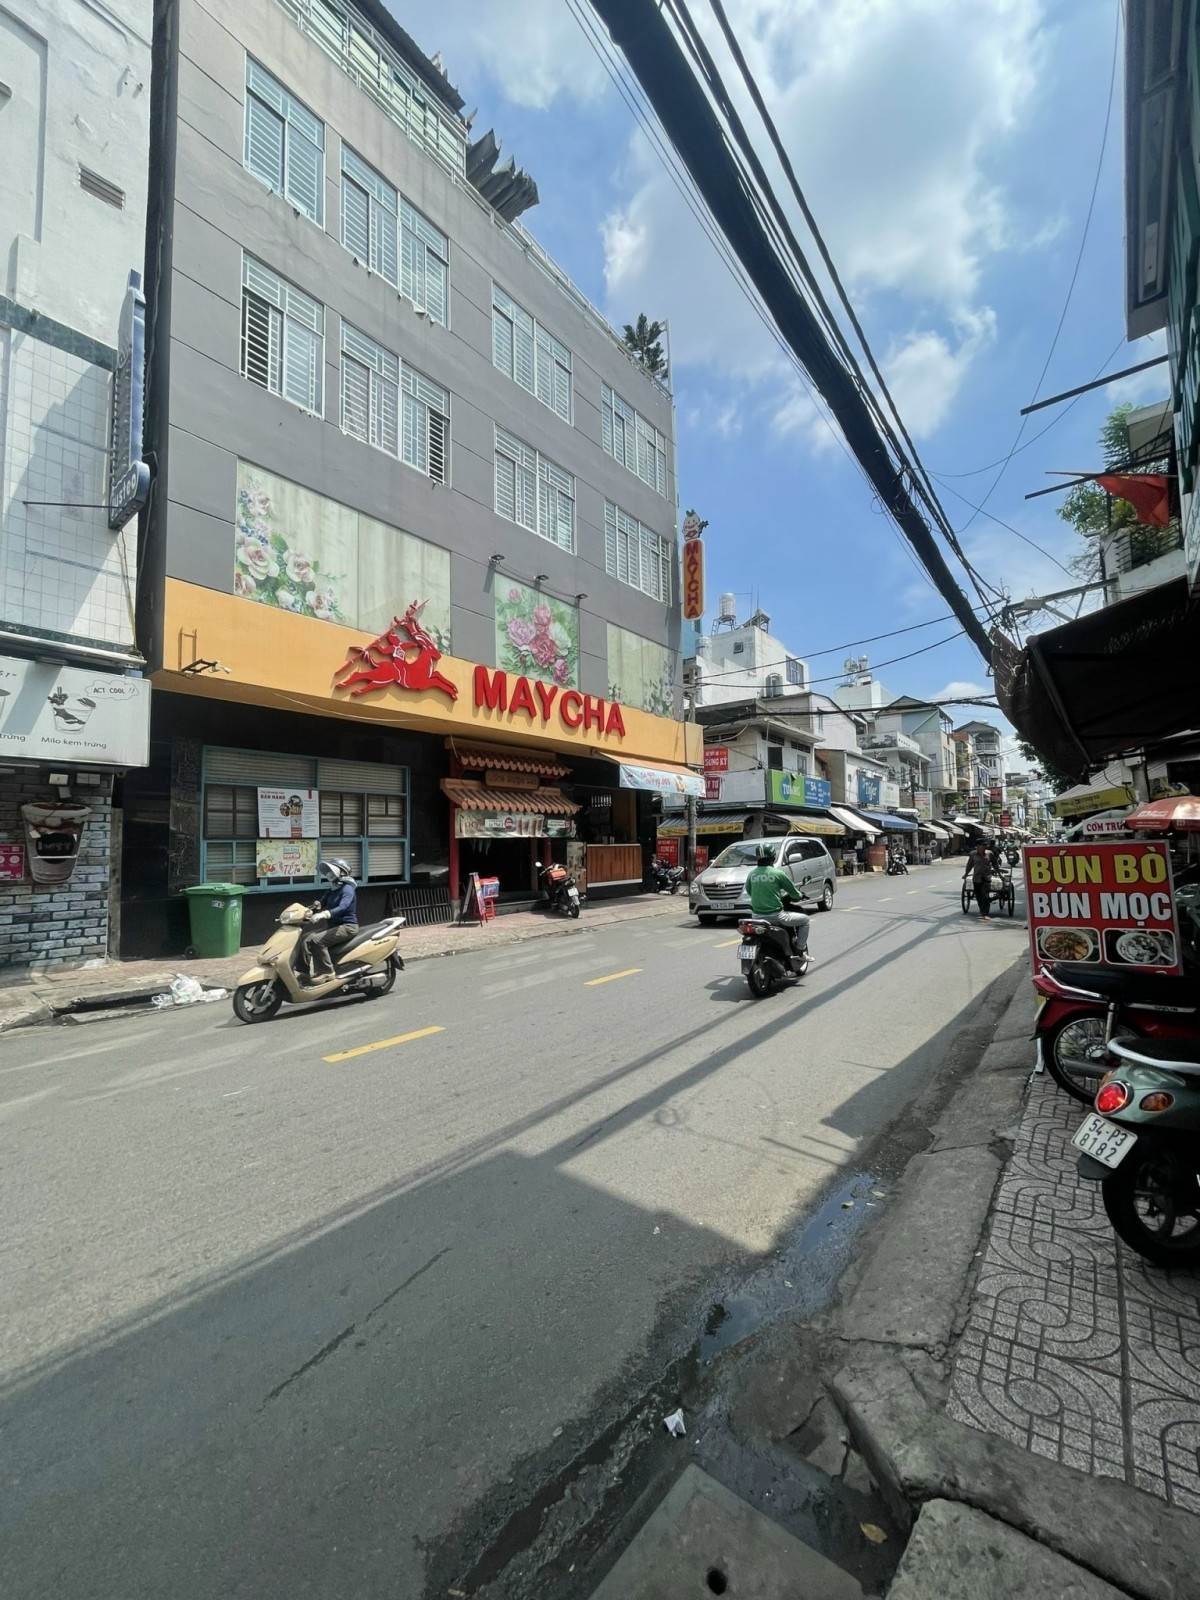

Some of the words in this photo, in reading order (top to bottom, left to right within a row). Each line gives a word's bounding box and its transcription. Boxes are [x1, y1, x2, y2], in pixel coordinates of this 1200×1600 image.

[686, 541, 699, 618] MAYCHA
[474, 665, 626, 737] MAYCHA
[41, 737, 61, 745] Milo
[84, 741, 107, 749] trứng
[750, 873, 775, 882] Grab
[1028, 849, 1103, 884] BÚN
[1113, 846, 1167, 884] BÒ
[1032, 886, 1091, 919] BÚN
[1100, 892, 1172, 926] MỌC
[1079, 1132, 1117, 1162] 8182
[1089, 1118, 1128, 1147] 54-P3
